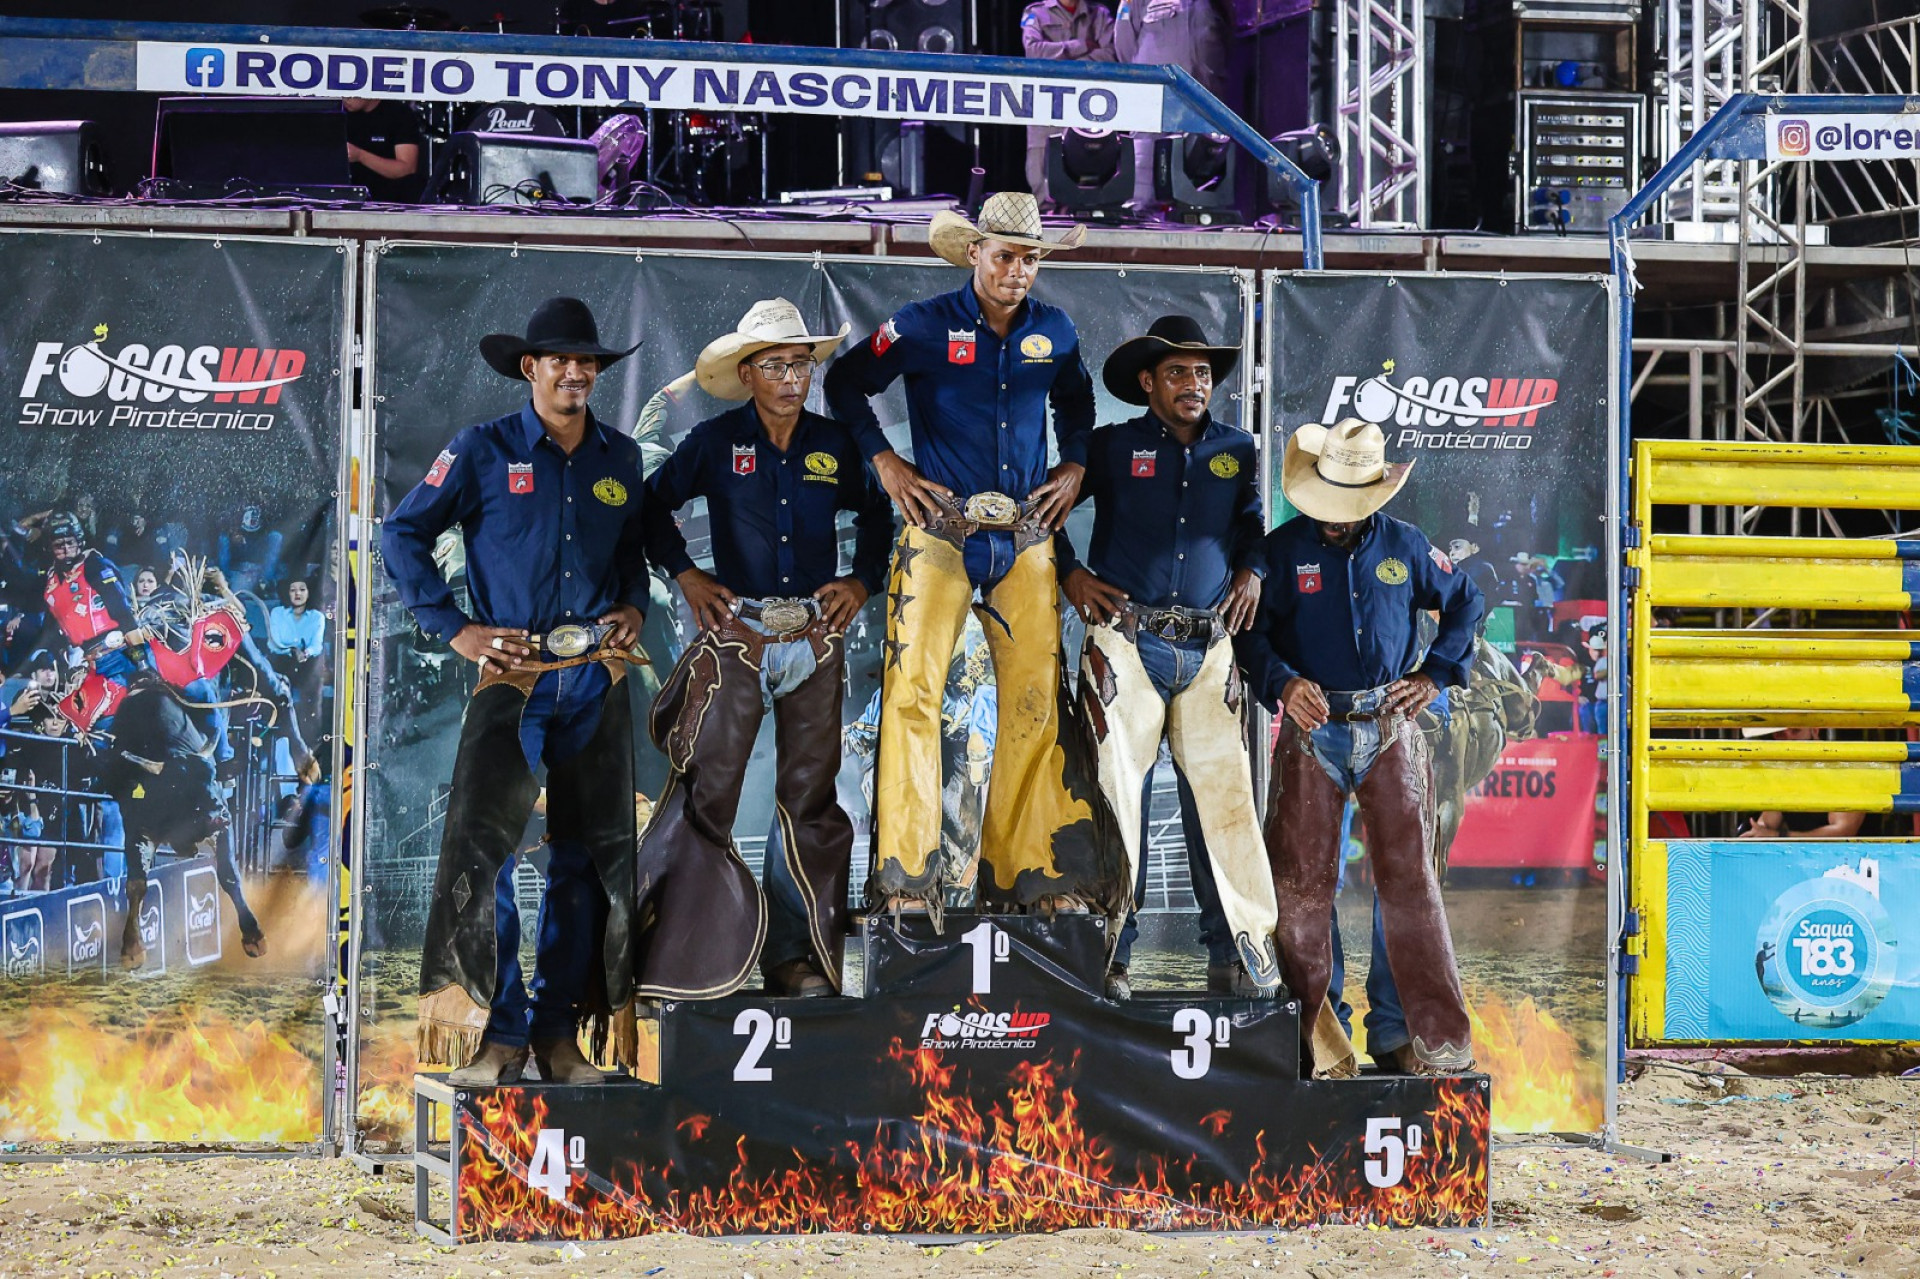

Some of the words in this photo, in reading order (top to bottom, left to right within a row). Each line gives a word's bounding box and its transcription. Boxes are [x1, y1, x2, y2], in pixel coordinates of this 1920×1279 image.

[235, 51, 475, 95] RODEIO
[495, 61, 677, 101] TONY
[694, 68, 1118, 122] NASCIMENTO
[488, 107, 535, 132] Pearl
[1815, 123, 1920, 151] @lore
[19, 402, 103, 427] Show
[108, 405, 275, 431] Pirotécnico
[1397, 429, 1532, 450] Pirotécnico
[1800, 919, 1854, 940] Saquá
[73, 937, 99, 961] Coral
[961, 922, 1010, 994] 1º
[1793, 937, 1856, 976] 183
[733, 1008, 791, 1081] 2º
[920, 1038, 959, 1050] Show
[961, 1038, 1036, 1050] Pirotécnico
[1171, 1008, 1231, 1080] 3º
[528, 1128, 585, 1200] 4º
[1364, 1116, 1422, 1188] 5º
